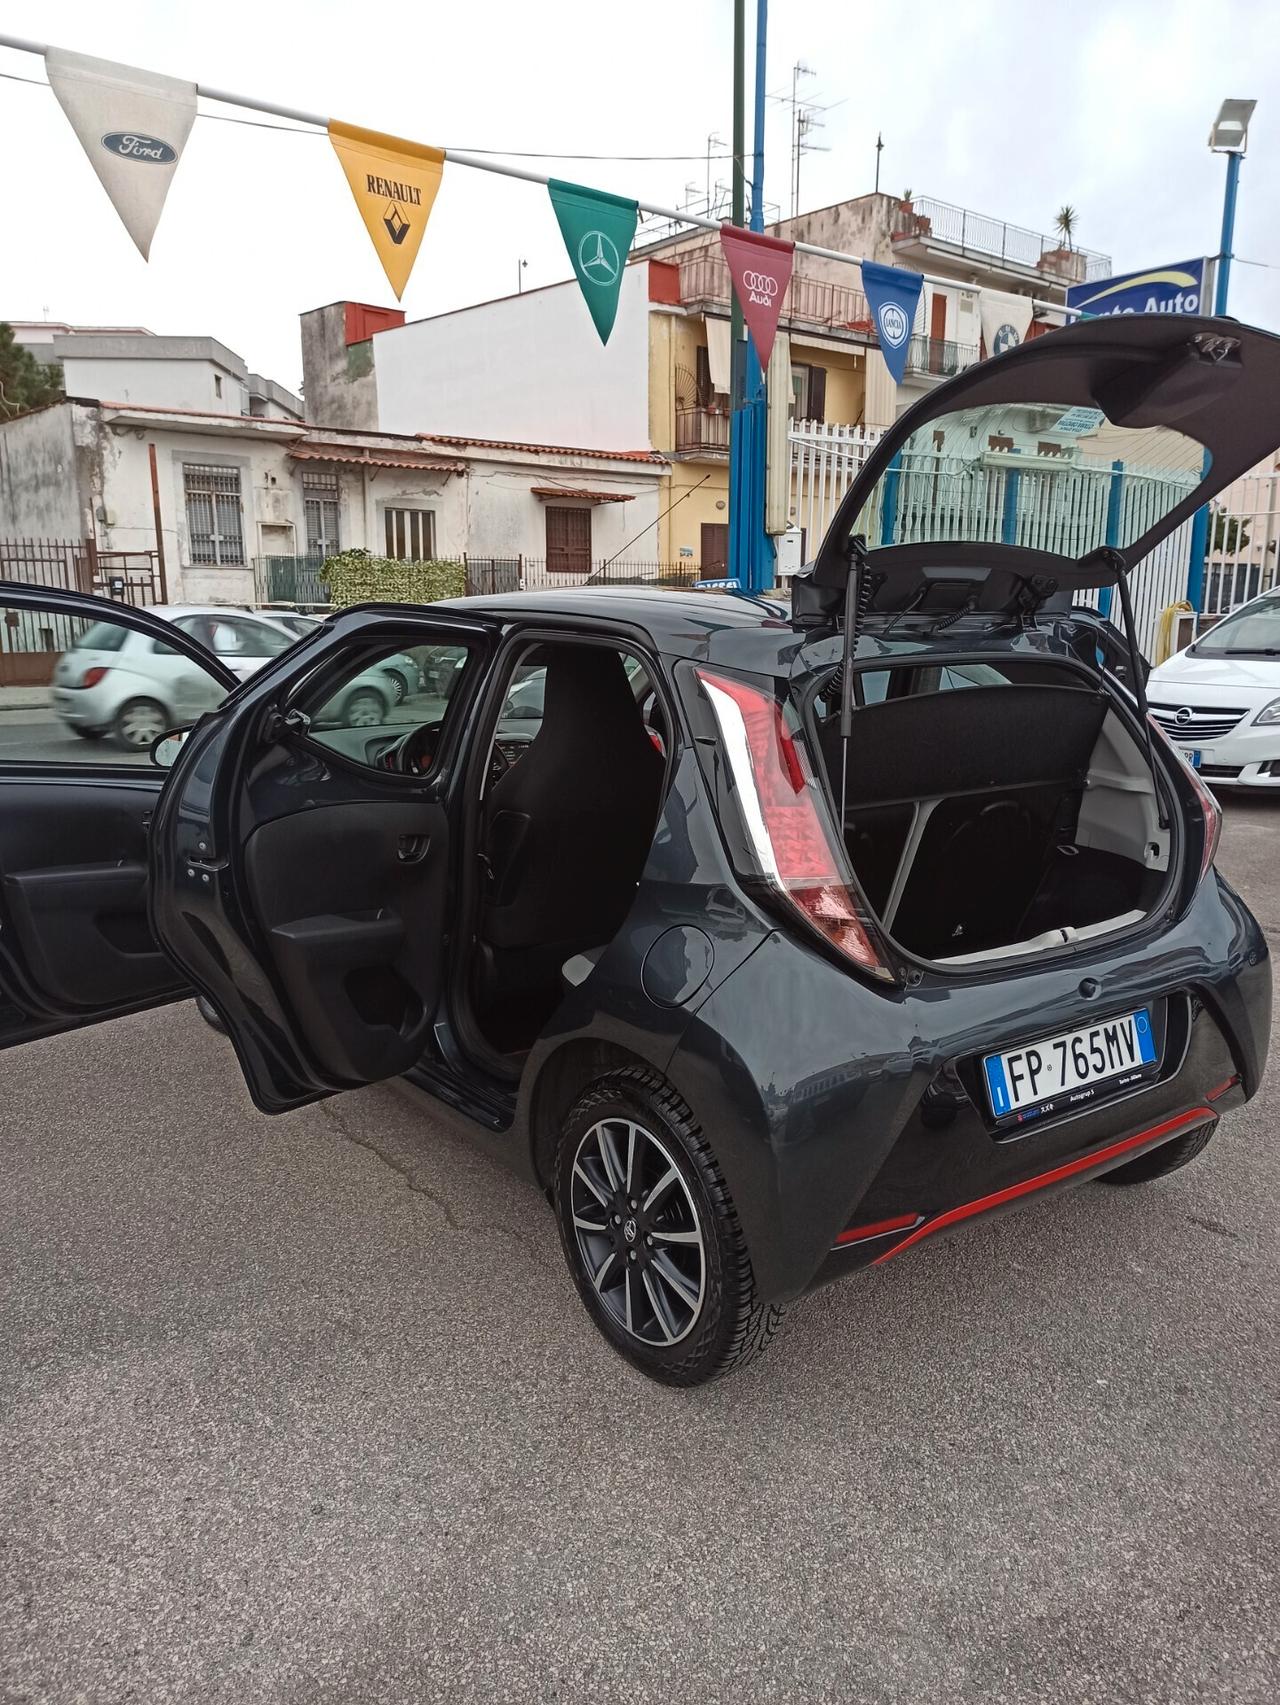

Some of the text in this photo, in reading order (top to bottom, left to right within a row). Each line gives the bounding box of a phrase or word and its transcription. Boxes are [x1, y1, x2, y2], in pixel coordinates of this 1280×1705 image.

[119, 135, 163, 160] Ford
[366, 174, 422, 206] RENAULT
[749, 290, 772, 307] Audi
[1144, 292, 1199, 313] Auto
[1007, 1049, 1043, 1102] FP
[1053, 1020, 1135, 1087] 765MV
